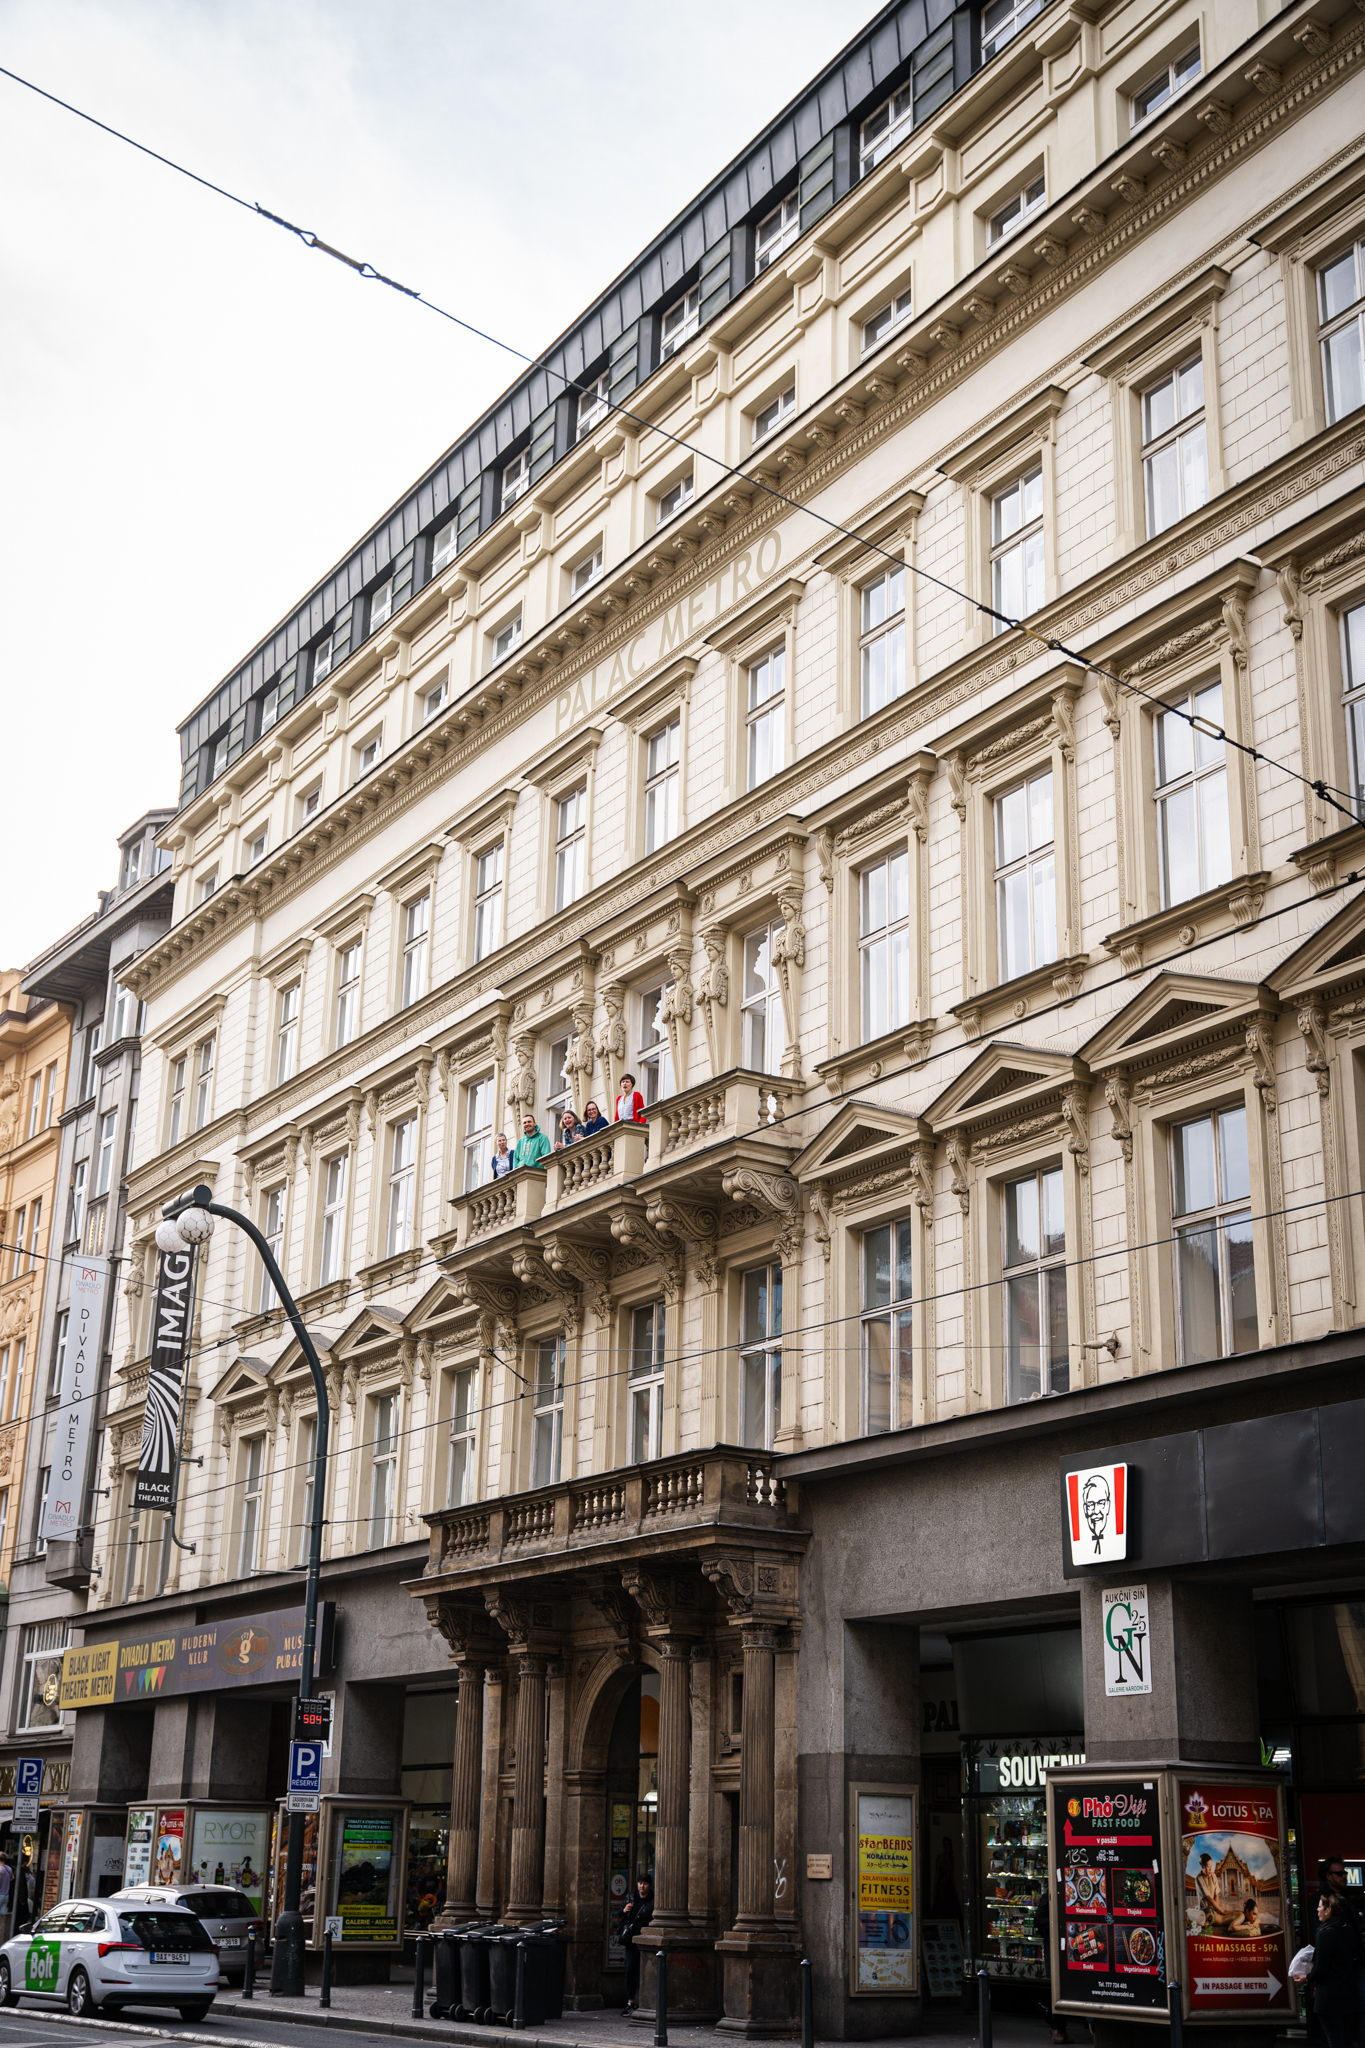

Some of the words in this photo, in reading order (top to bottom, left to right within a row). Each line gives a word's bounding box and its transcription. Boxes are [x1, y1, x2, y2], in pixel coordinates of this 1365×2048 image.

[658, 530, 782, 660] METRO
[76, 1280, 101, 1289] DIVADLO
[78, 1287, 99, 1295] METRO
[156, 1244, 191, 1349] IMAG
[71, 1308, 90, 1401] DIVADLO
[62, 1413, 79, 1481] METRO
[138, 1482, 170, 1493] BLACK
[138, 1494, 170, 1502] THEATRE
[48, 1513, 75, 1522] DIVADLO
[50, 1520, 72, 1528] METRO
[1105, 1589, 1131, 1604] AUKČNÍ
[1132, 1588, 1145, 1600] SÍŇ
[182, 1628, 218, 1650] HUDEBNÍ
[284, 1635, 302, 1651] MUS
[120, 1643, 149, 1668] DIVADLO
[150, 1638, 176, 1663] METRO
[188, 1651, 208, 1666] KLUB
[69, 1654, 90, 1676] BLACK
[92, 1650, 111, 1672] LIGHT
[276, 1656, 290, 1670] PUB
[291, 1655, 297, 1667] &
[62, 1678, 89, 1702] THEATRE
[90, 1675, 114, 1698] METRO
[1126, 1684, 1144, 1692] NÁRODNÍ
[303, 1714, 322, 1724] 504
[297, 1748, 316, 1776] P
[22, 1763, 38, 1784] P
[1000, 1754, 1086, 1787] SOUV
[1212, 1804, 1248, 1818] LOTUS
[1092, 1819, 1113, 1827] FAST
[1116, 1819, 1140, 1827] FOOD
[204, 1822, 256, 1840] RYOR
[866, 1852, 908, 1861] KORÁLKÁRNA
[862, 1884, 910, 1896] FITNESS
[1194, 1944, 1214, 1952] THAI
[1216, 1944, 1256, 1952] MASSAGE
[1263, 1944, 1278, 1952] SPA
[30, 1952, 53, 1980] Bolt
